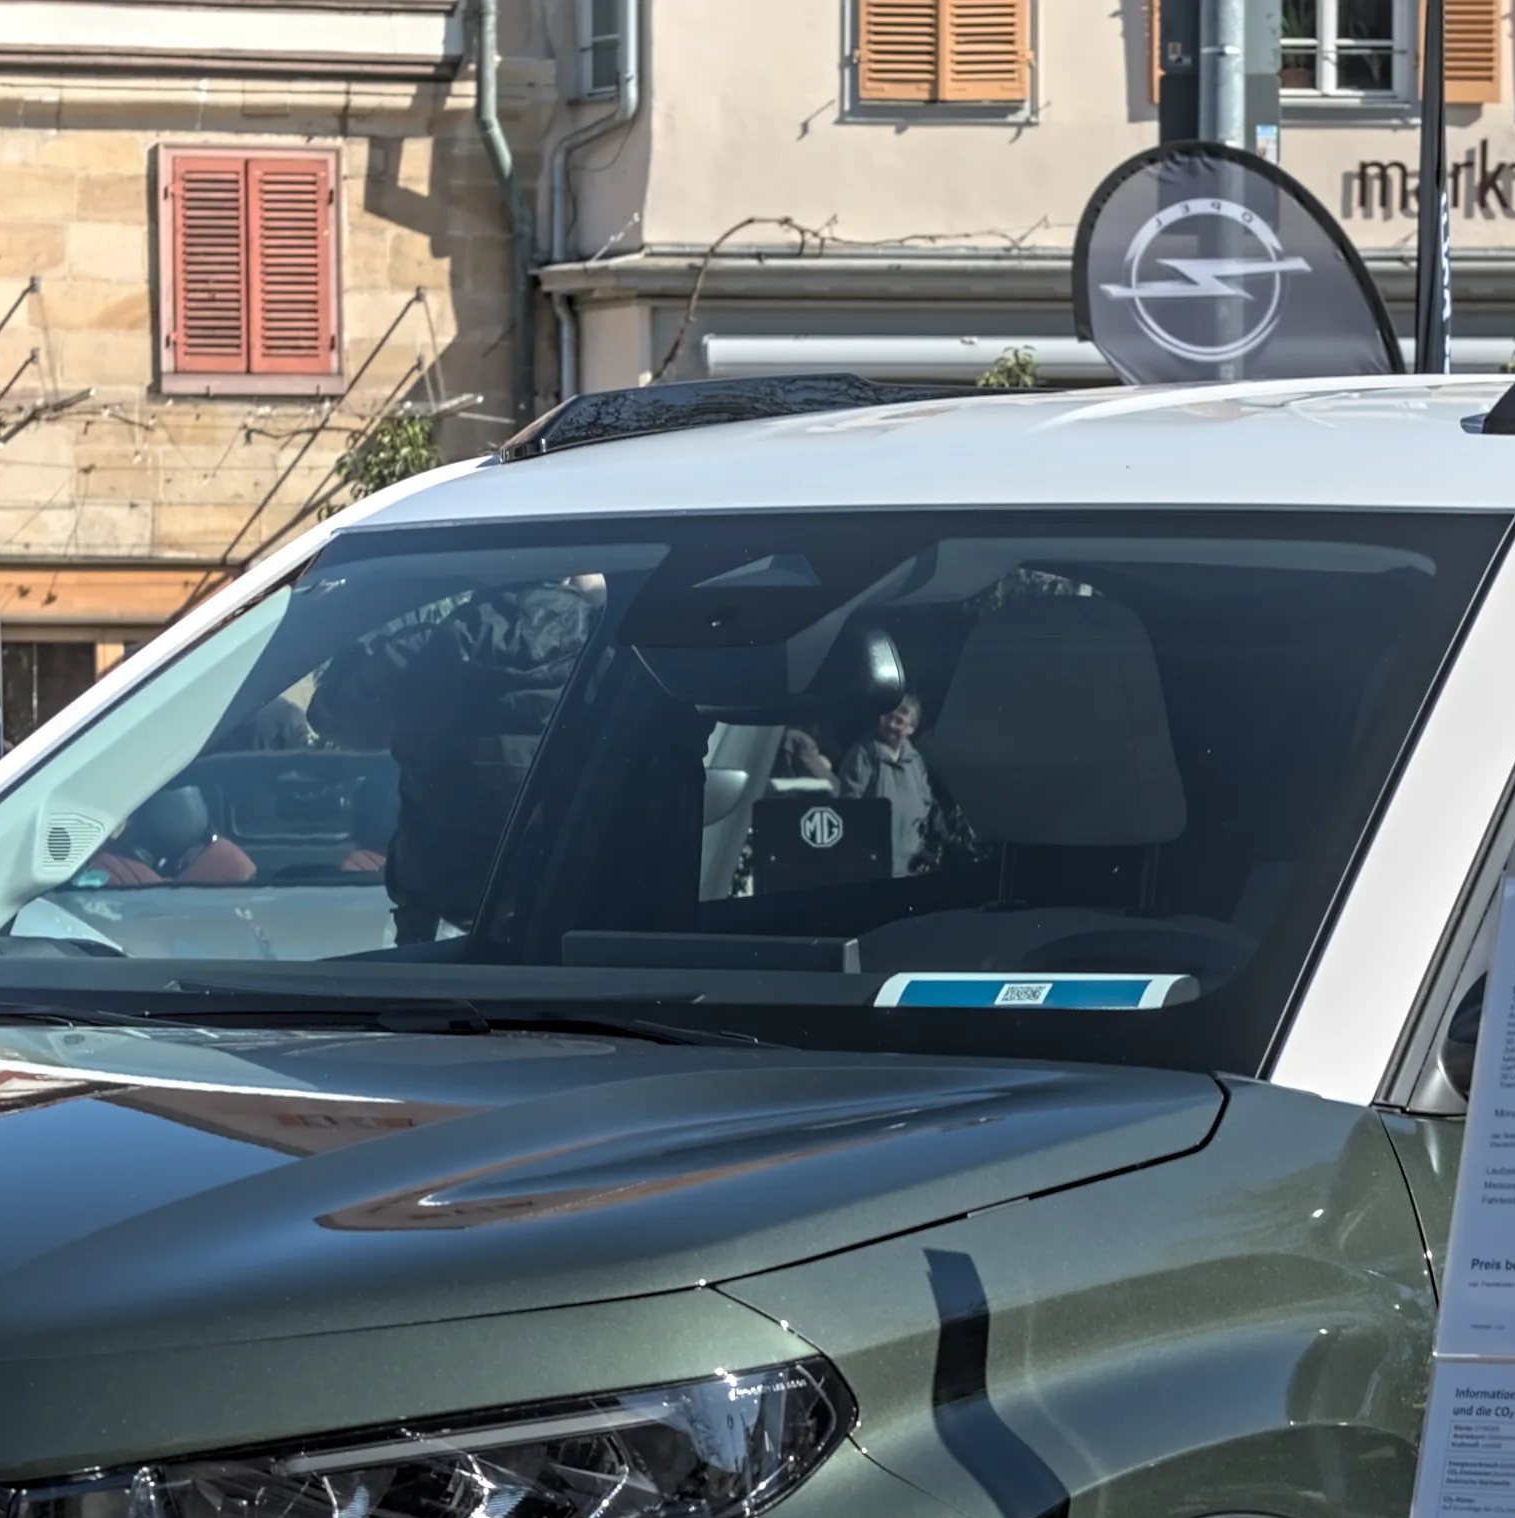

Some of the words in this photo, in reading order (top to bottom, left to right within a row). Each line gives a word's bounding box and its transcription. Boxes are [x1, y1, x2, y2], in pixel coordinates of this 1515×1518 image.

[805, 811, 839, 845] MG
[1470, 1258, 1501, 1270] Preis
[1453, 1406, 1473, 1416] und
[1476, 1406, 1491, 1417] die
